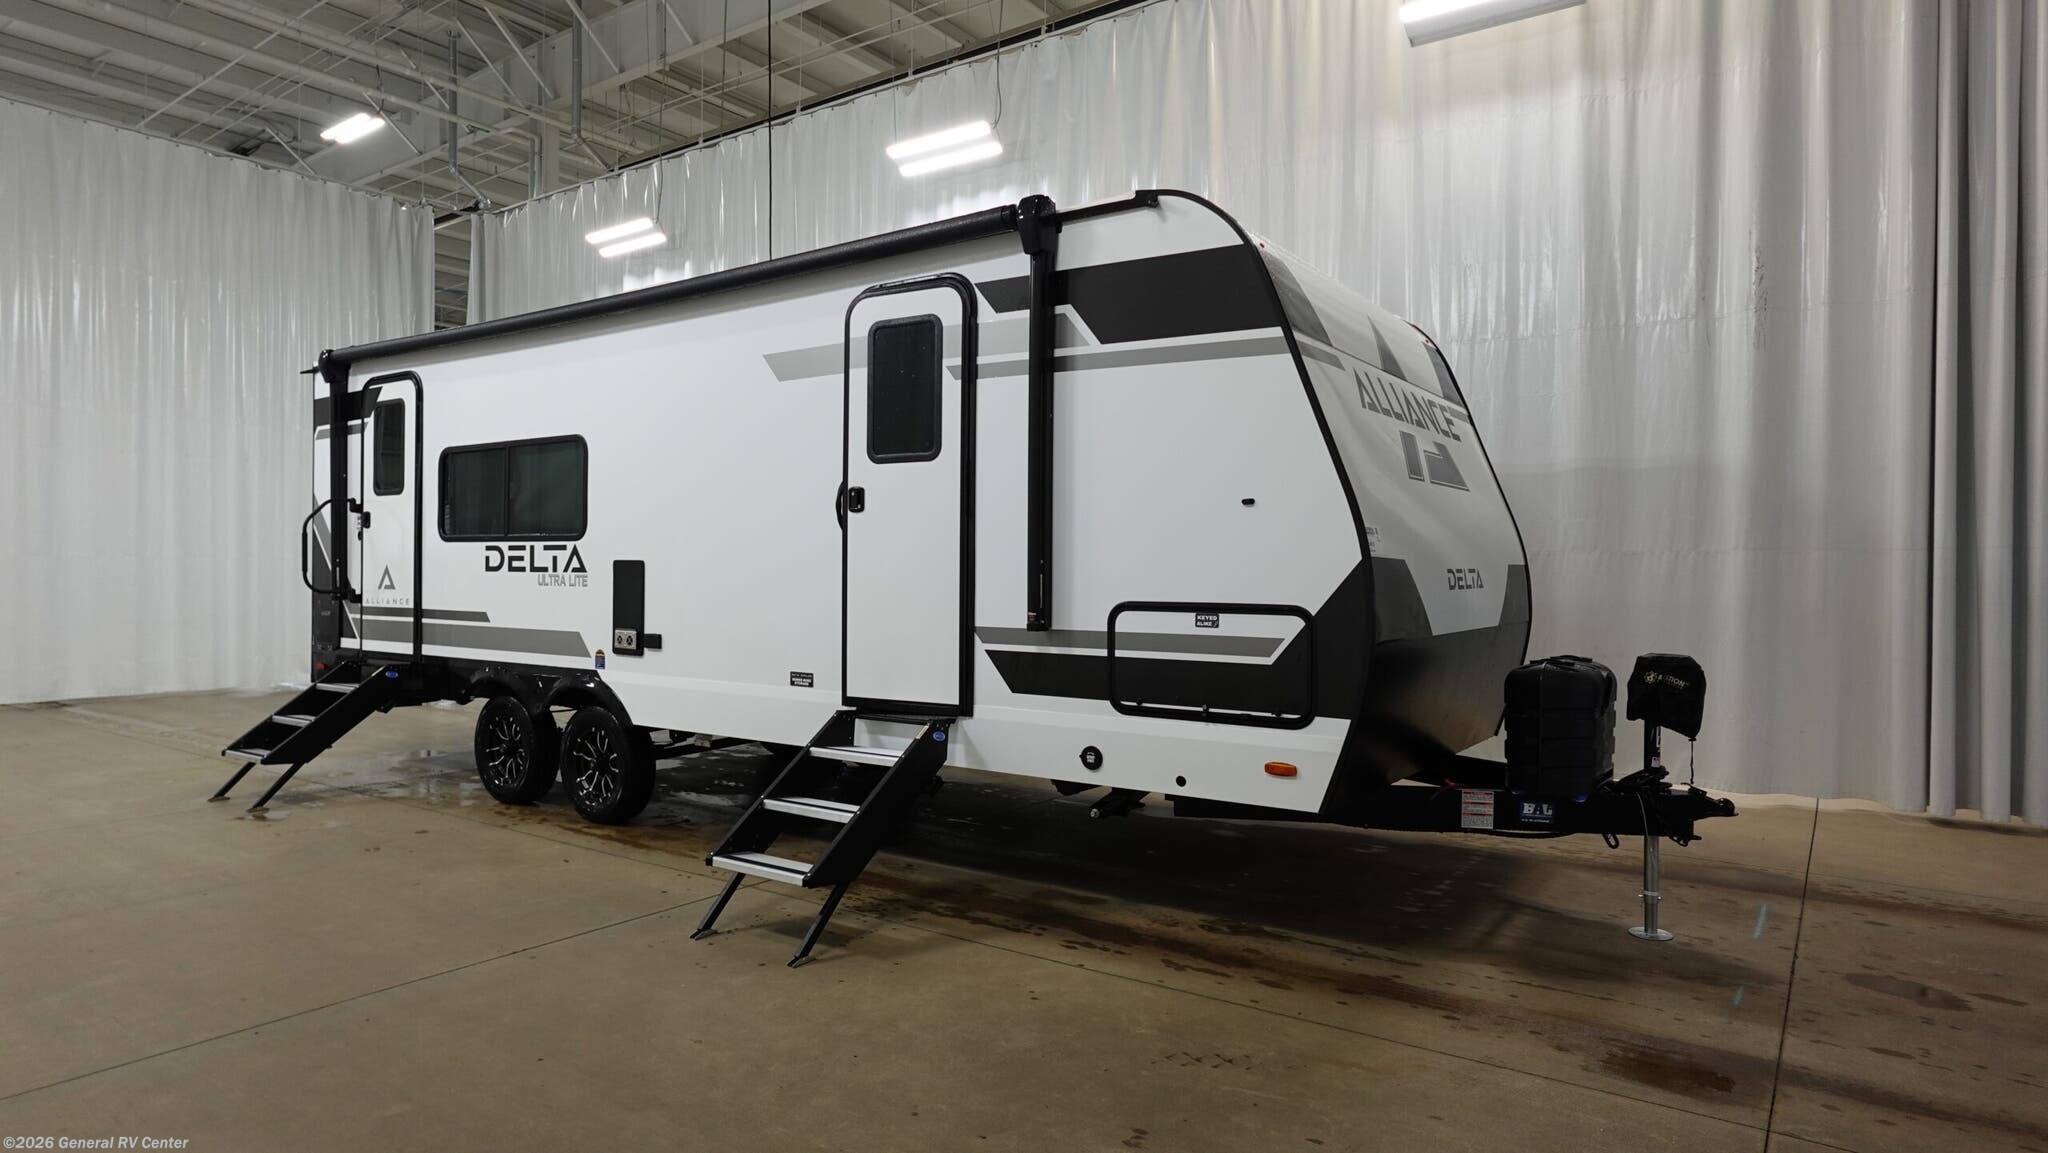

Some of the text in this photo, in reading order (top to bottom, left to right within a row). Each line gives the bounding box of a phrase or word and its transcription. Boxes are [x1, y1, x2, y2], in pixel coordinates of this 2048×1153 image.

[1352, 366, 1462, 442] ALLIANCE
[484, 543, 588, 573] DELTA
[537, 573, 588, 587] ULTRA LITE
[1446, 567, 1485, 591] DELTA
[364, 597, 410, 606] ALLIANCE
